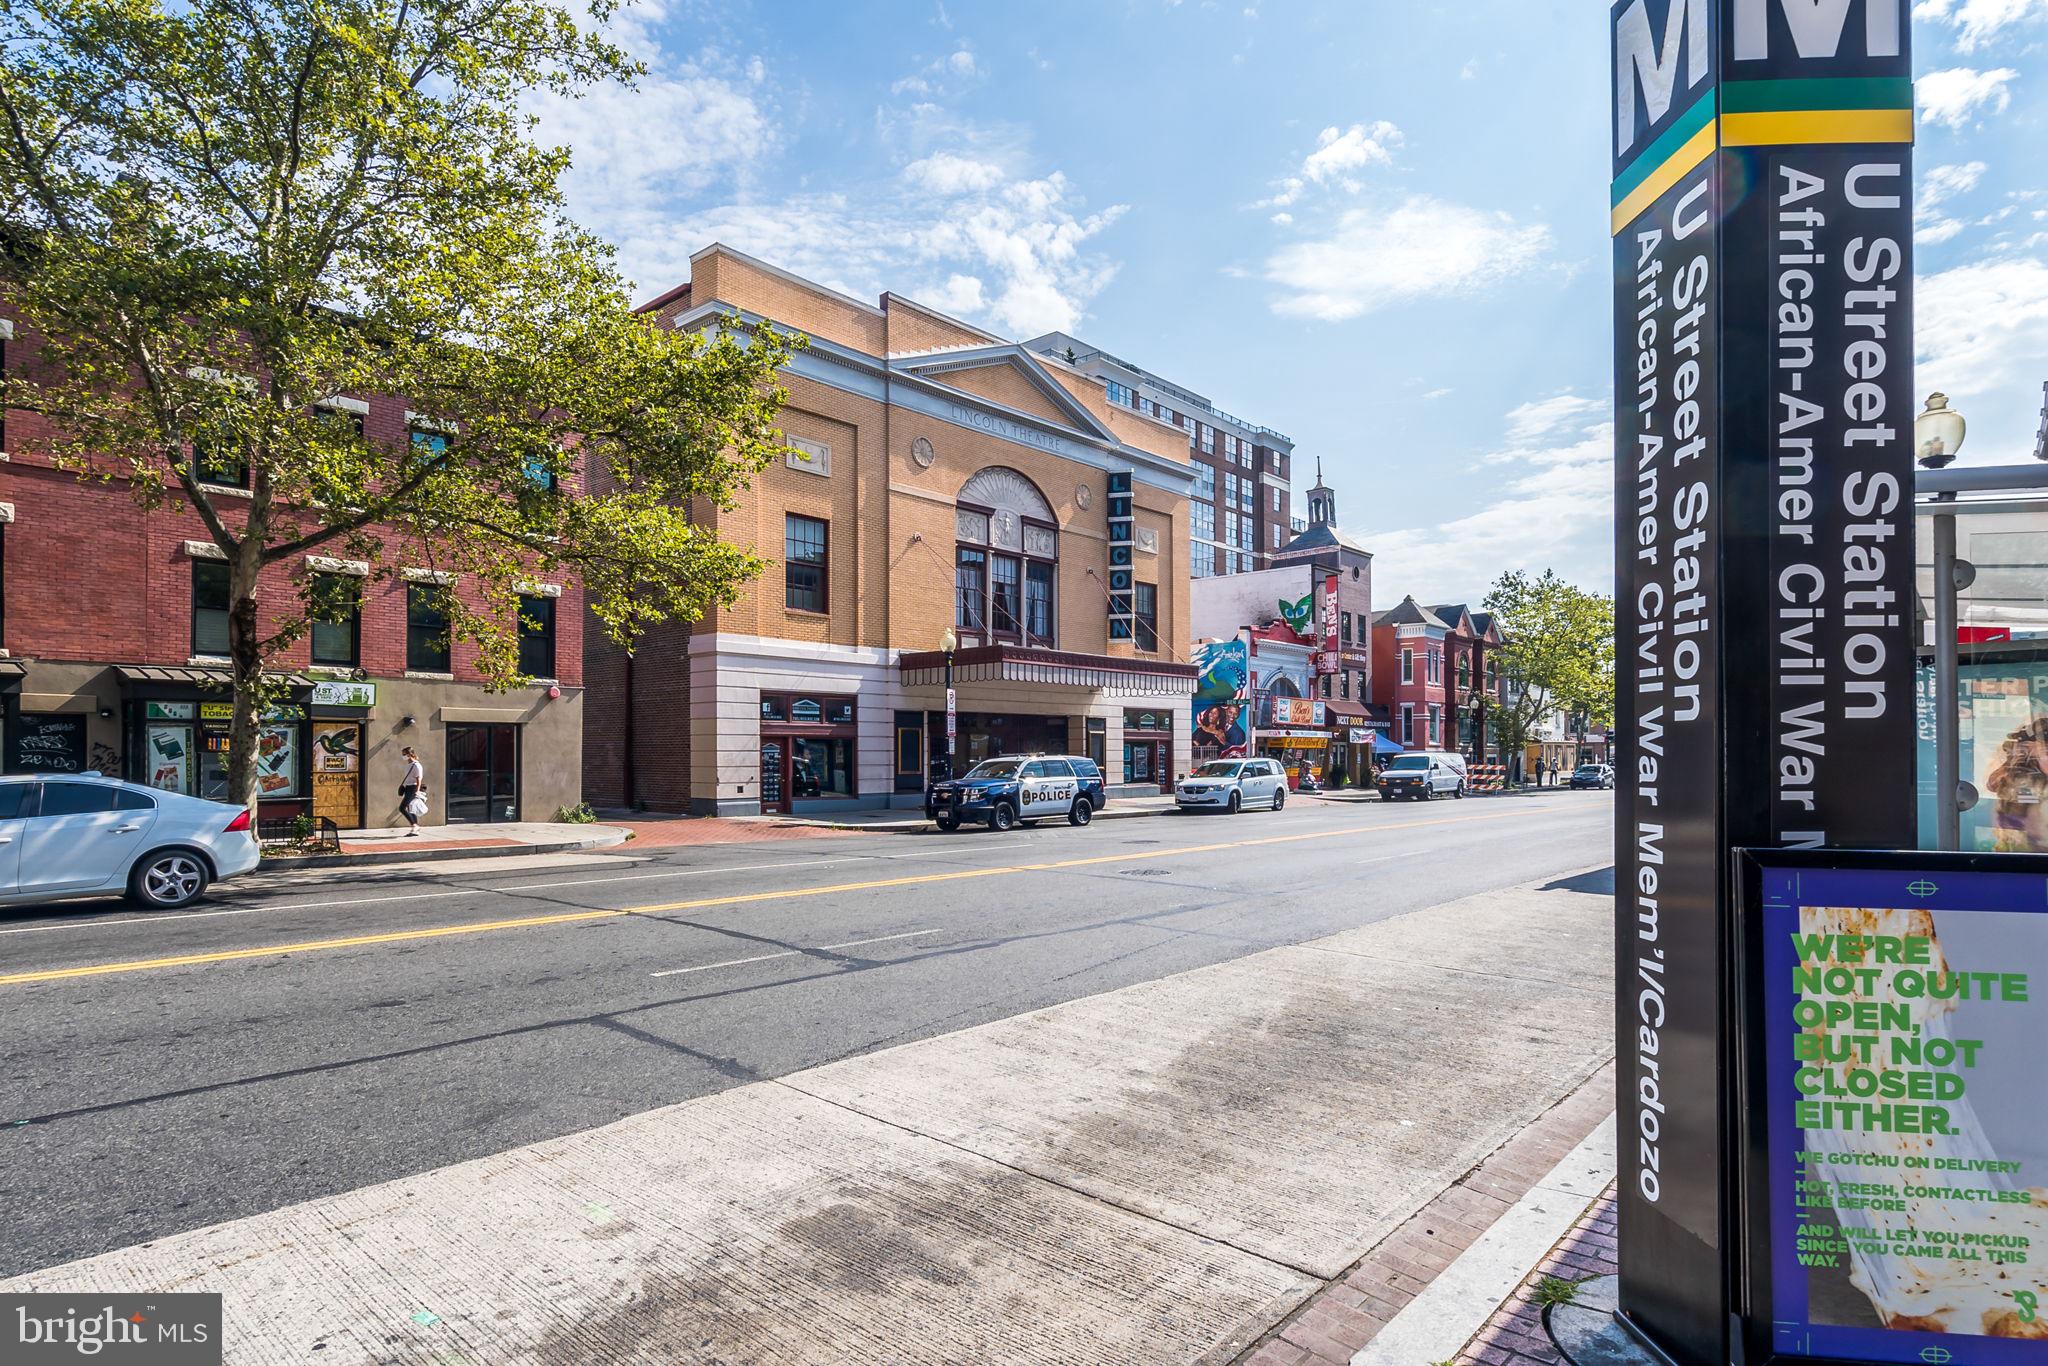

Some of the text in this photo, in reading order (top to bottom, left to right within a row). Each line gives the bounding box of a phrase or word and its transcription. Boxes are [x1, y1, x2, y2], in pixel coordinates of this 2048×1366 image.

[1778, 165, 1825, 544] African-Amer
[1637, 228, 1664, 565] African-Amer
[951, 405, 1061, 451] LINCOLN THEATRE
[1843, 164, 1901, 719] U Street Station
[1672, 178, 1708, 722] U Street Station
[1112, 475, 1128, 638] LINCOLN
[1326, 590, 1338, 637] BEN'S
[1779, 563, 1825, 685] Civil
[1638, 582, 1664, 693] Civil
[1317, 652, 1338, 662] CHILI
[1317, 661, 1338, 670] BOWL
[1293, 702, 1310, 715] Ben's
[1336, 715, 1350, 725] NEXT
[1350, 716, 1363, 726] DOOR
[1638, 705, 1664, 806] War
[1780, 701, 1825, 810] War
[1032, 789, 1072, 802] POLICE
[1790, 933, 1931, 965] WE'RE
[1792, 966, 2029, 1002] NOT QUITE
[1792, 1000, 1921, 1037] OPEN,
[1793, 1033, 1984, 1068] BUT NOT
[1793, 1066, 1966, 1101] CLOSED
[1795, 1100, 1960, 1136] EITHER.
[1795, 1151, 2023, 1174] WE GOTCHU ON DELIVERY
[1795, 1180, 2031, 1204] HOT, FRESH, CONTACTLESS
[1795, 1195, 1906, 1212] LIKE BEFORE
[1796, 1224, 2030, 1249] AND WILL LET YOU PICKUP
[1796, 1239, 2027, 1264] SINCE YOU CAME ALL THIS
[1796, 1254, 1840, 1268] WAY.
